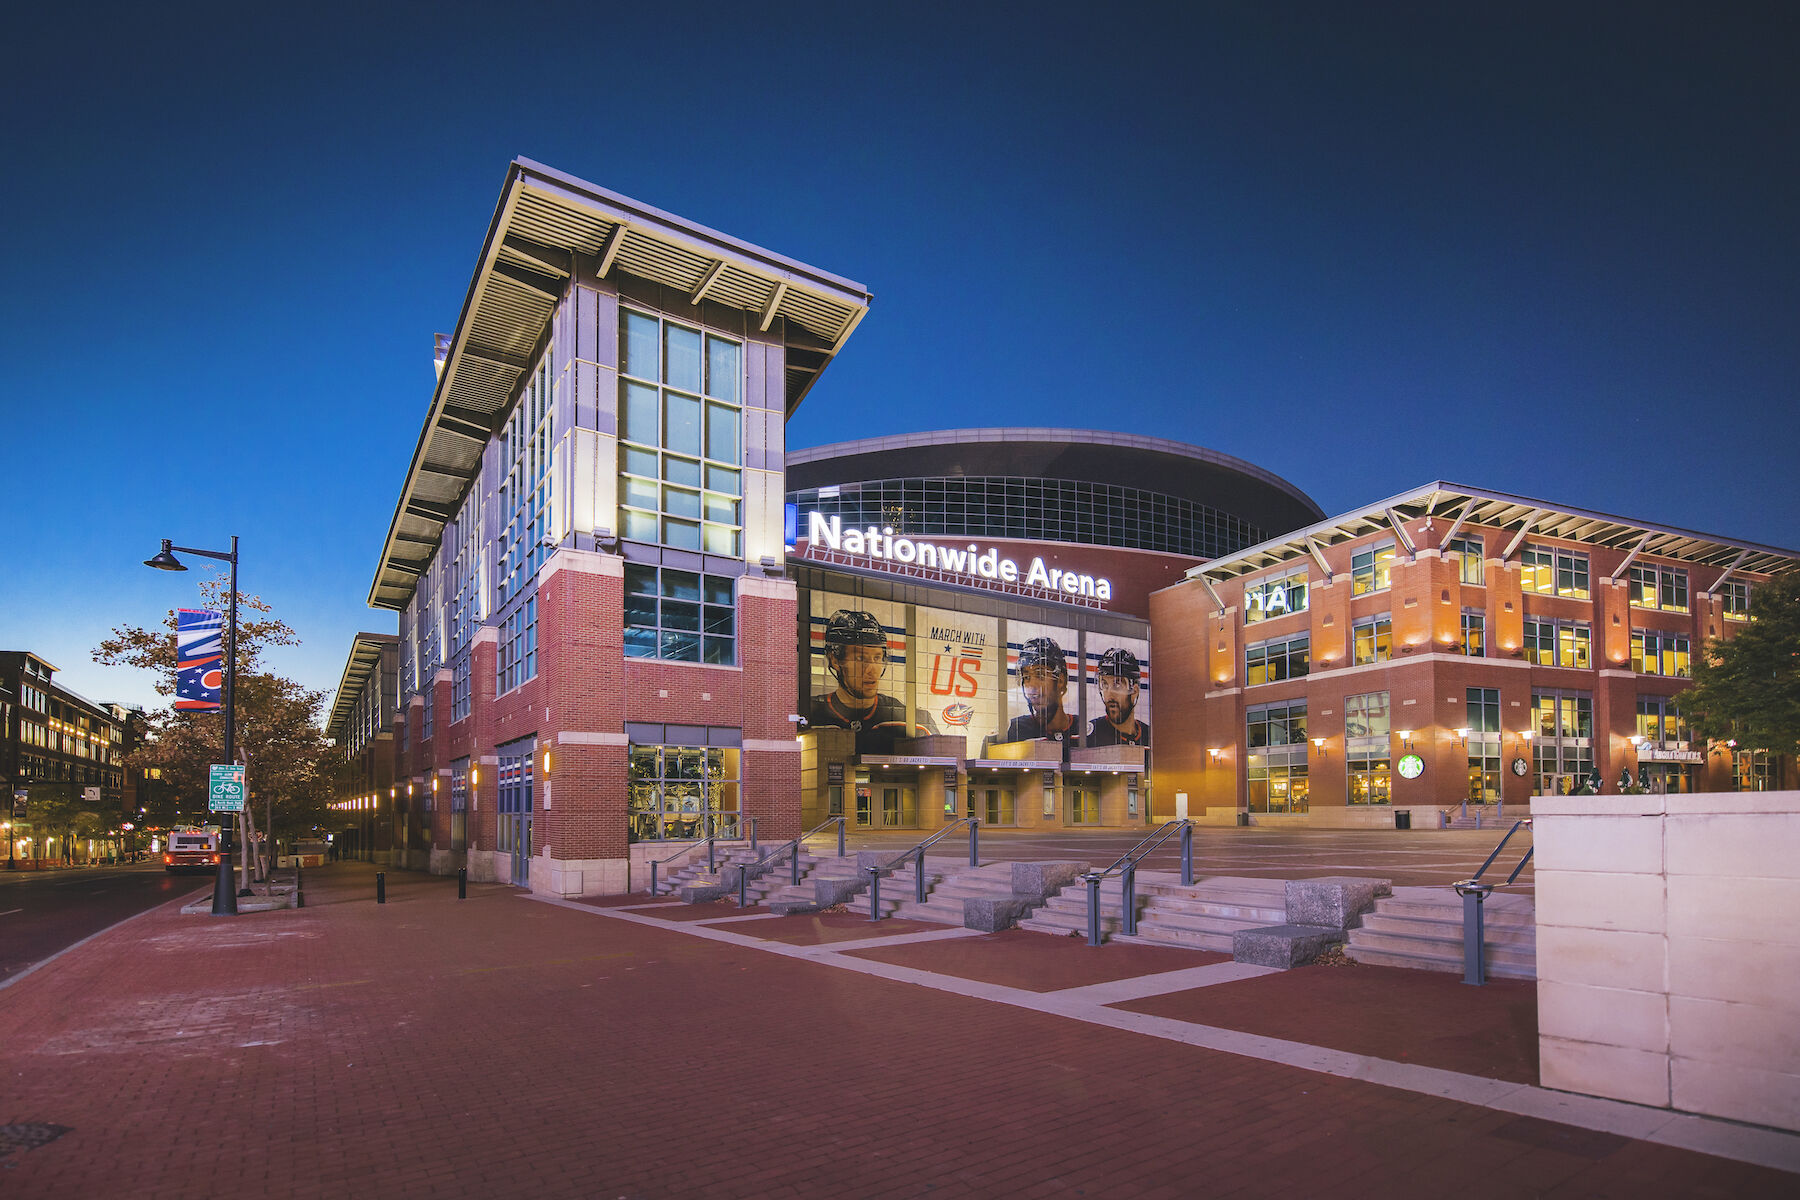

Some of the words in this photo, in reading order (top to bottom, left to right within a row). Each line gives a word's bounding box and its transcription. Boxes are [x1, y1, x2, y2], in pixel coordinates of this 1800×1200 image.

[809, 511, 1018, 582] Nationwide
[1026, 556, 1112, 600] Arena
[930, 627, 961, 643] MARCH
[963, 632, 986, 646] WITH
[930, 654, 981, 698] US
